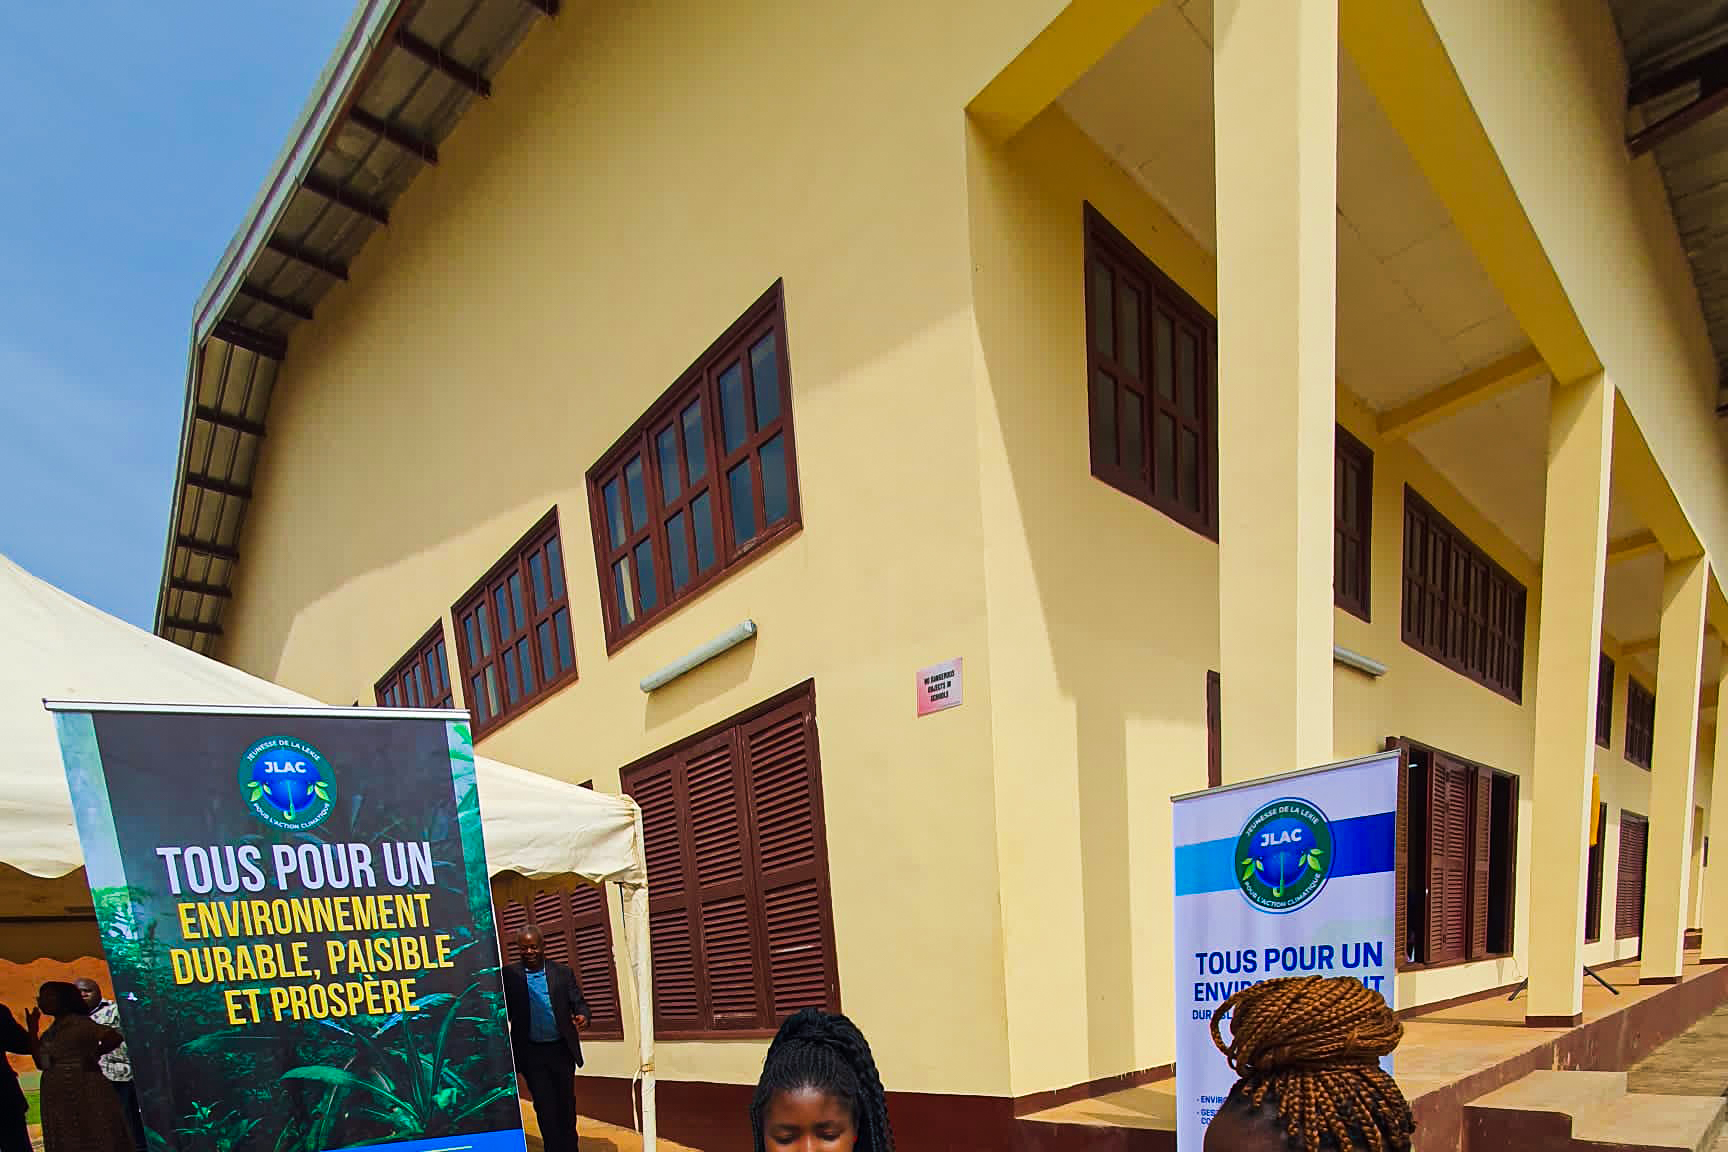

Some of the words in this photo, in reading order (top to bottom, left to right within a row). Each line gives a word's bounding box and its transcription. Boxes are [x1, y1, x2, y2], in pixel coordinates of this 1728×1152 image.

[264, 761, 306, 774] JLAC
[1245, 808, 1278, 836] JEUNESSE
[1260, 828, 1302, 847] JLAC
[156, 846, 266, 895] TOUS
[272, 842, 376, 891] POUR
[383, 841, 436, 887] UN
[1244, 880, 1257, 898] POUR
[1256, 894, 1286, 908] L'ACTION
[1287, 873, 1321, 906] CLIMATIQUE
[178, 894, 432, 940] ENVIRONNEMENT
[170, 942, 321, 985] DURABLE,
[326, 934, 455, 976] PAISIBLE
[1195, 948, 1258, 976] TOUS
[1264, 944, 1335, 972] POUR
[1342, 941, 1383, 969] UN
[224, 988, 261, 1026] ET
[270, 974, 420, 1022] PROSPÈRE
